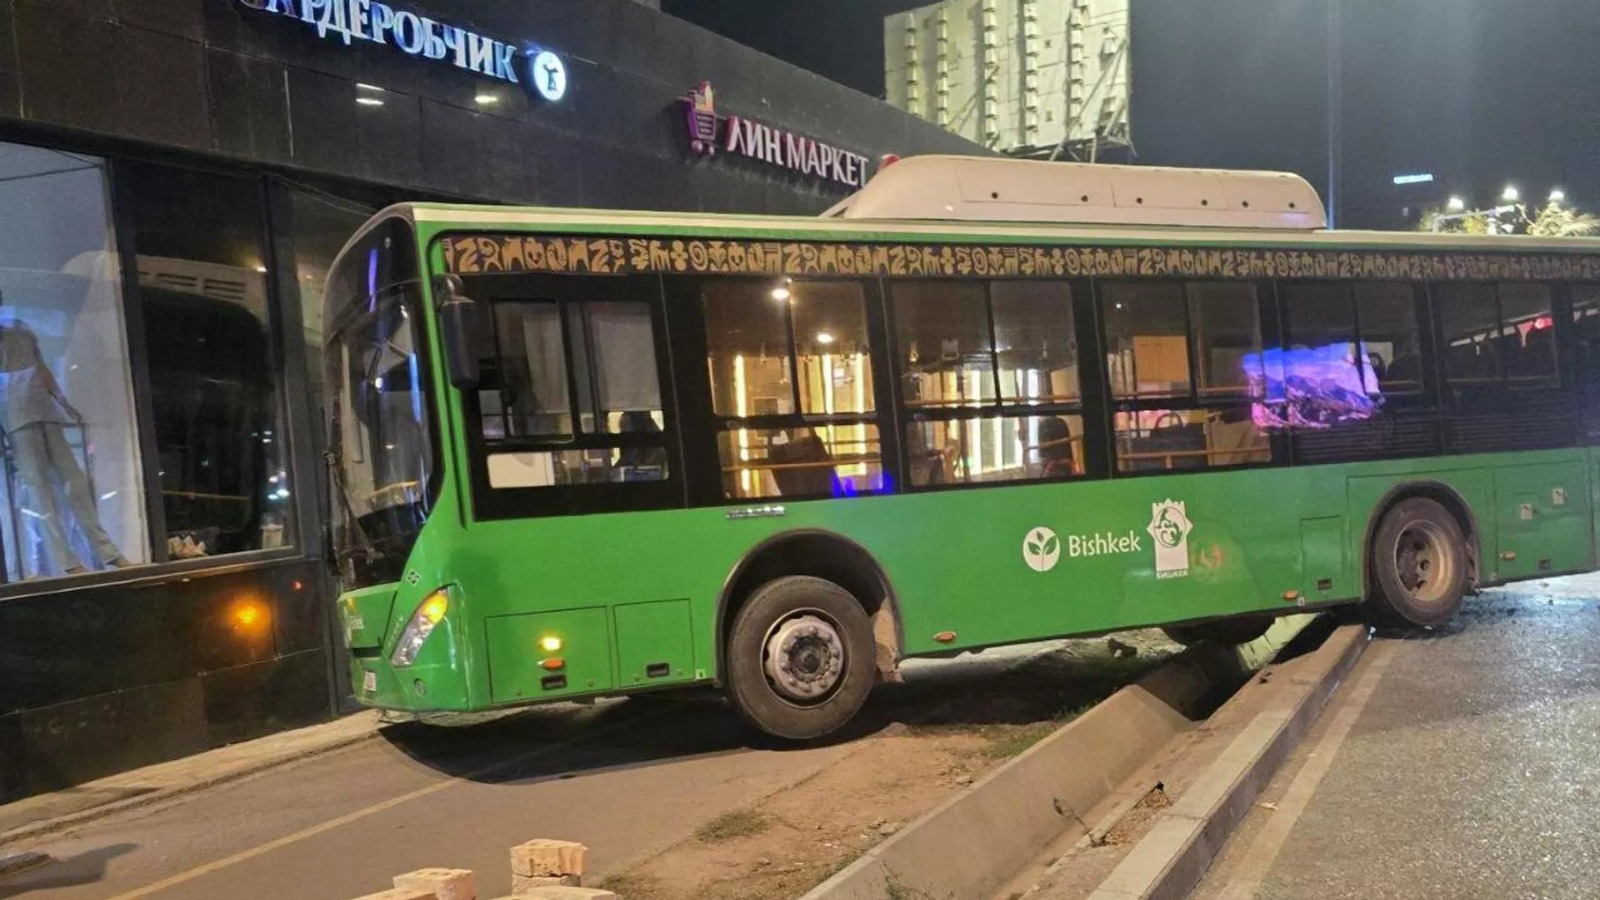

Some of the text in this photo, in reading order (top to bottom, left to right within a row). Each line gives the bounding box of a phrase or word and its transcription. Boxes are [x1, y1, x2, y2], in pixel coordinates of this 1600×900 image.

[240, 0, 518, 83] РДЕРОБЧИК
[726, 115, 869, 188] ЛИН МАРКЕТ
[1068, 530, 1141, 557] Bishkek
